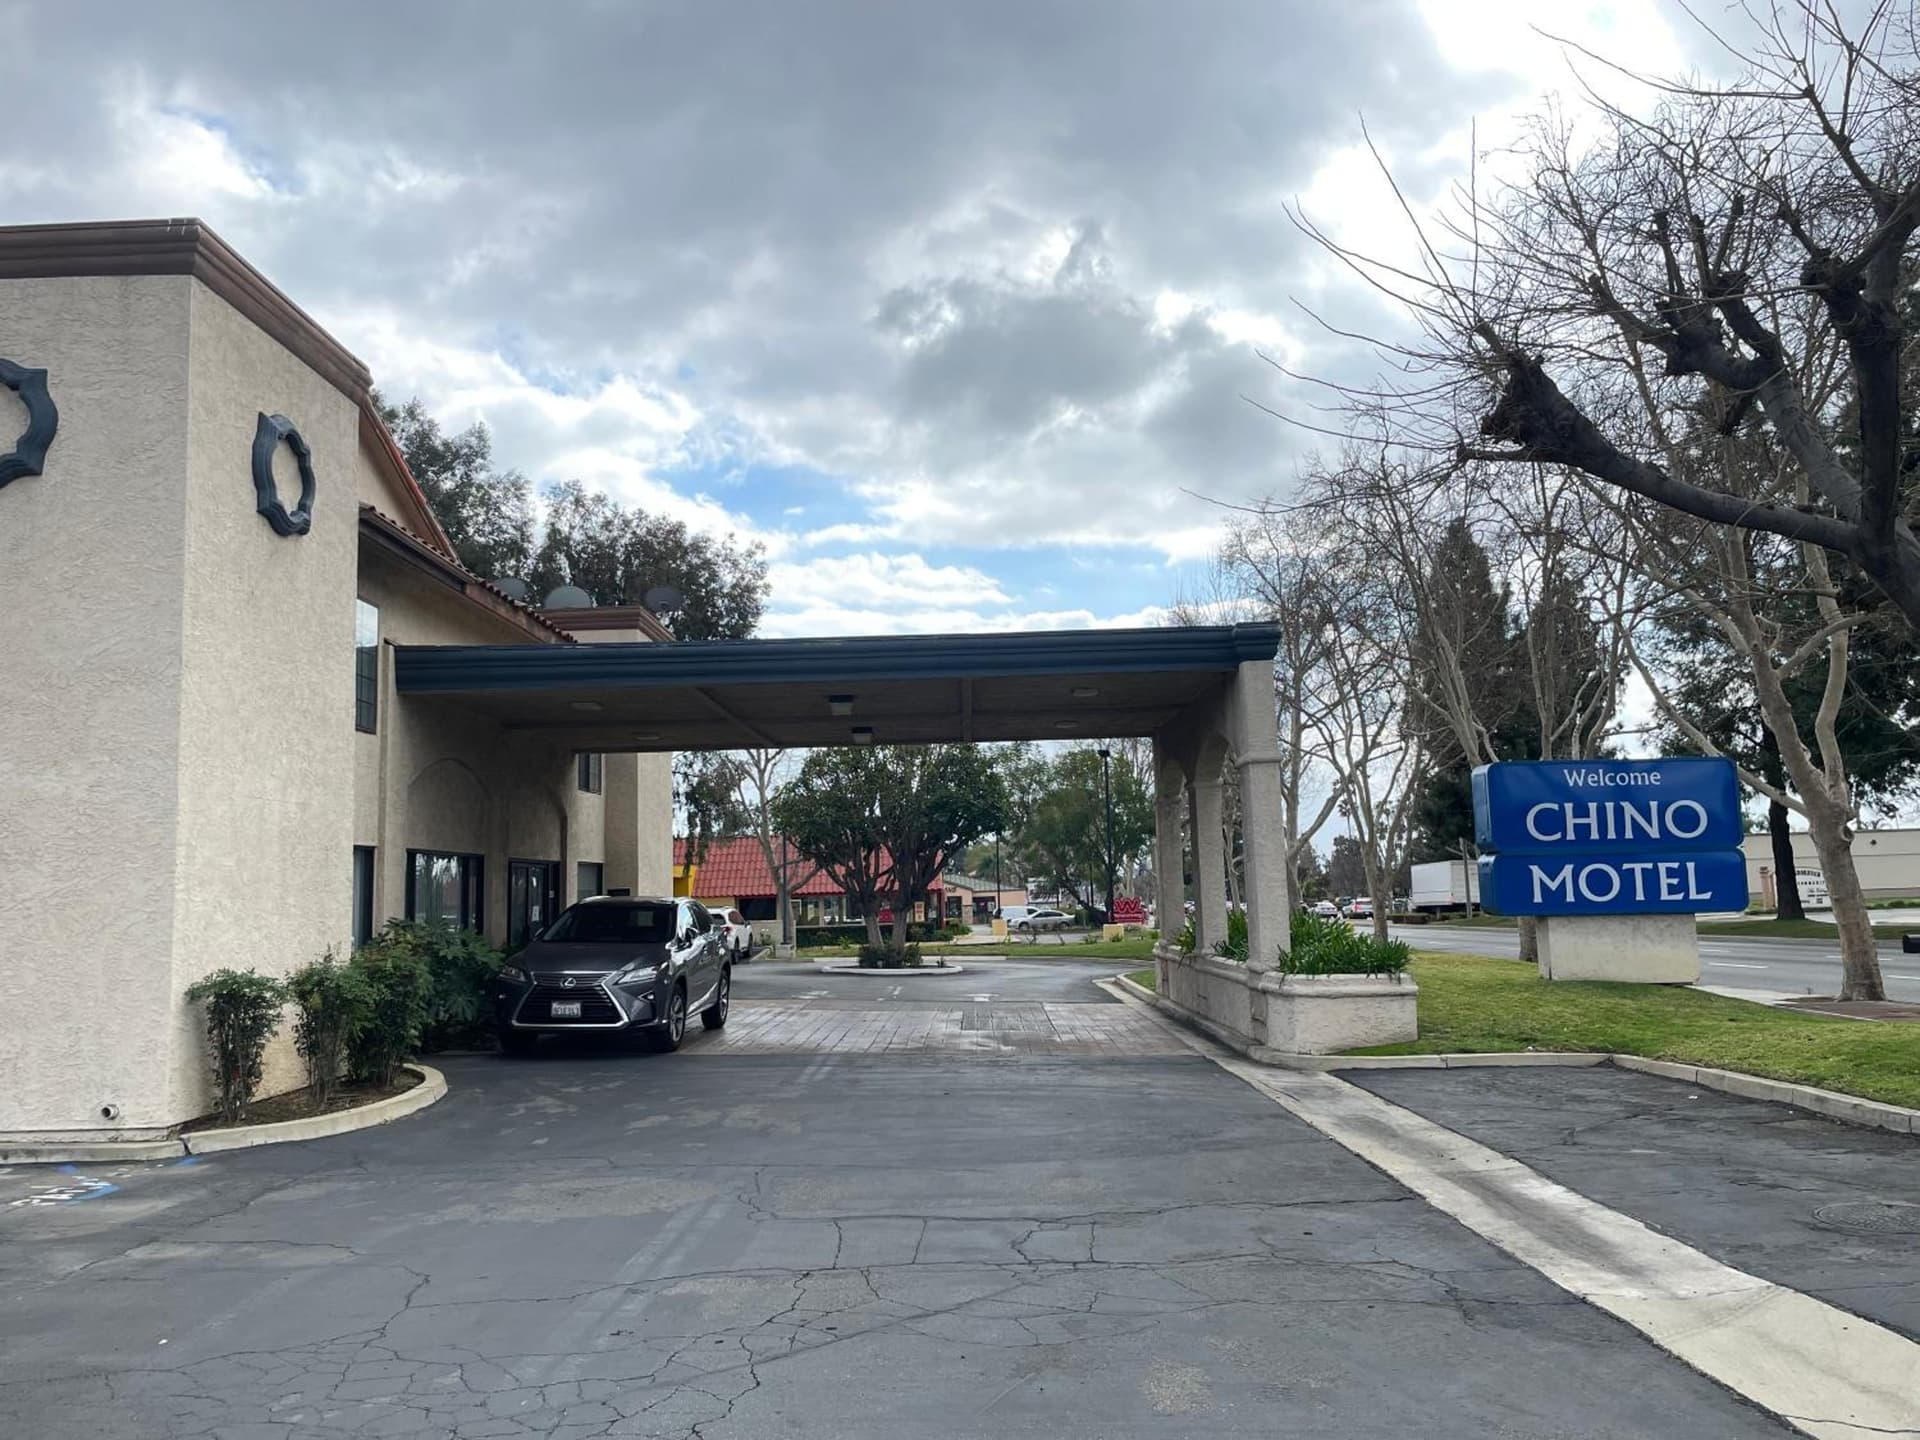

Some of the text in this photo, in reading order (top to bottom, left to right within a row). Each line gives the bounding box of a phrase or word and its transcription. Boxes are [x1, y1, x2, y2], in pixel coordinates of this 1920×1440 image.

[1563, 768, 1662, 788] Welcome
[1525, 799, 1709, 842] CHINO
[1528, 861, 1713, 904] MOTEL
